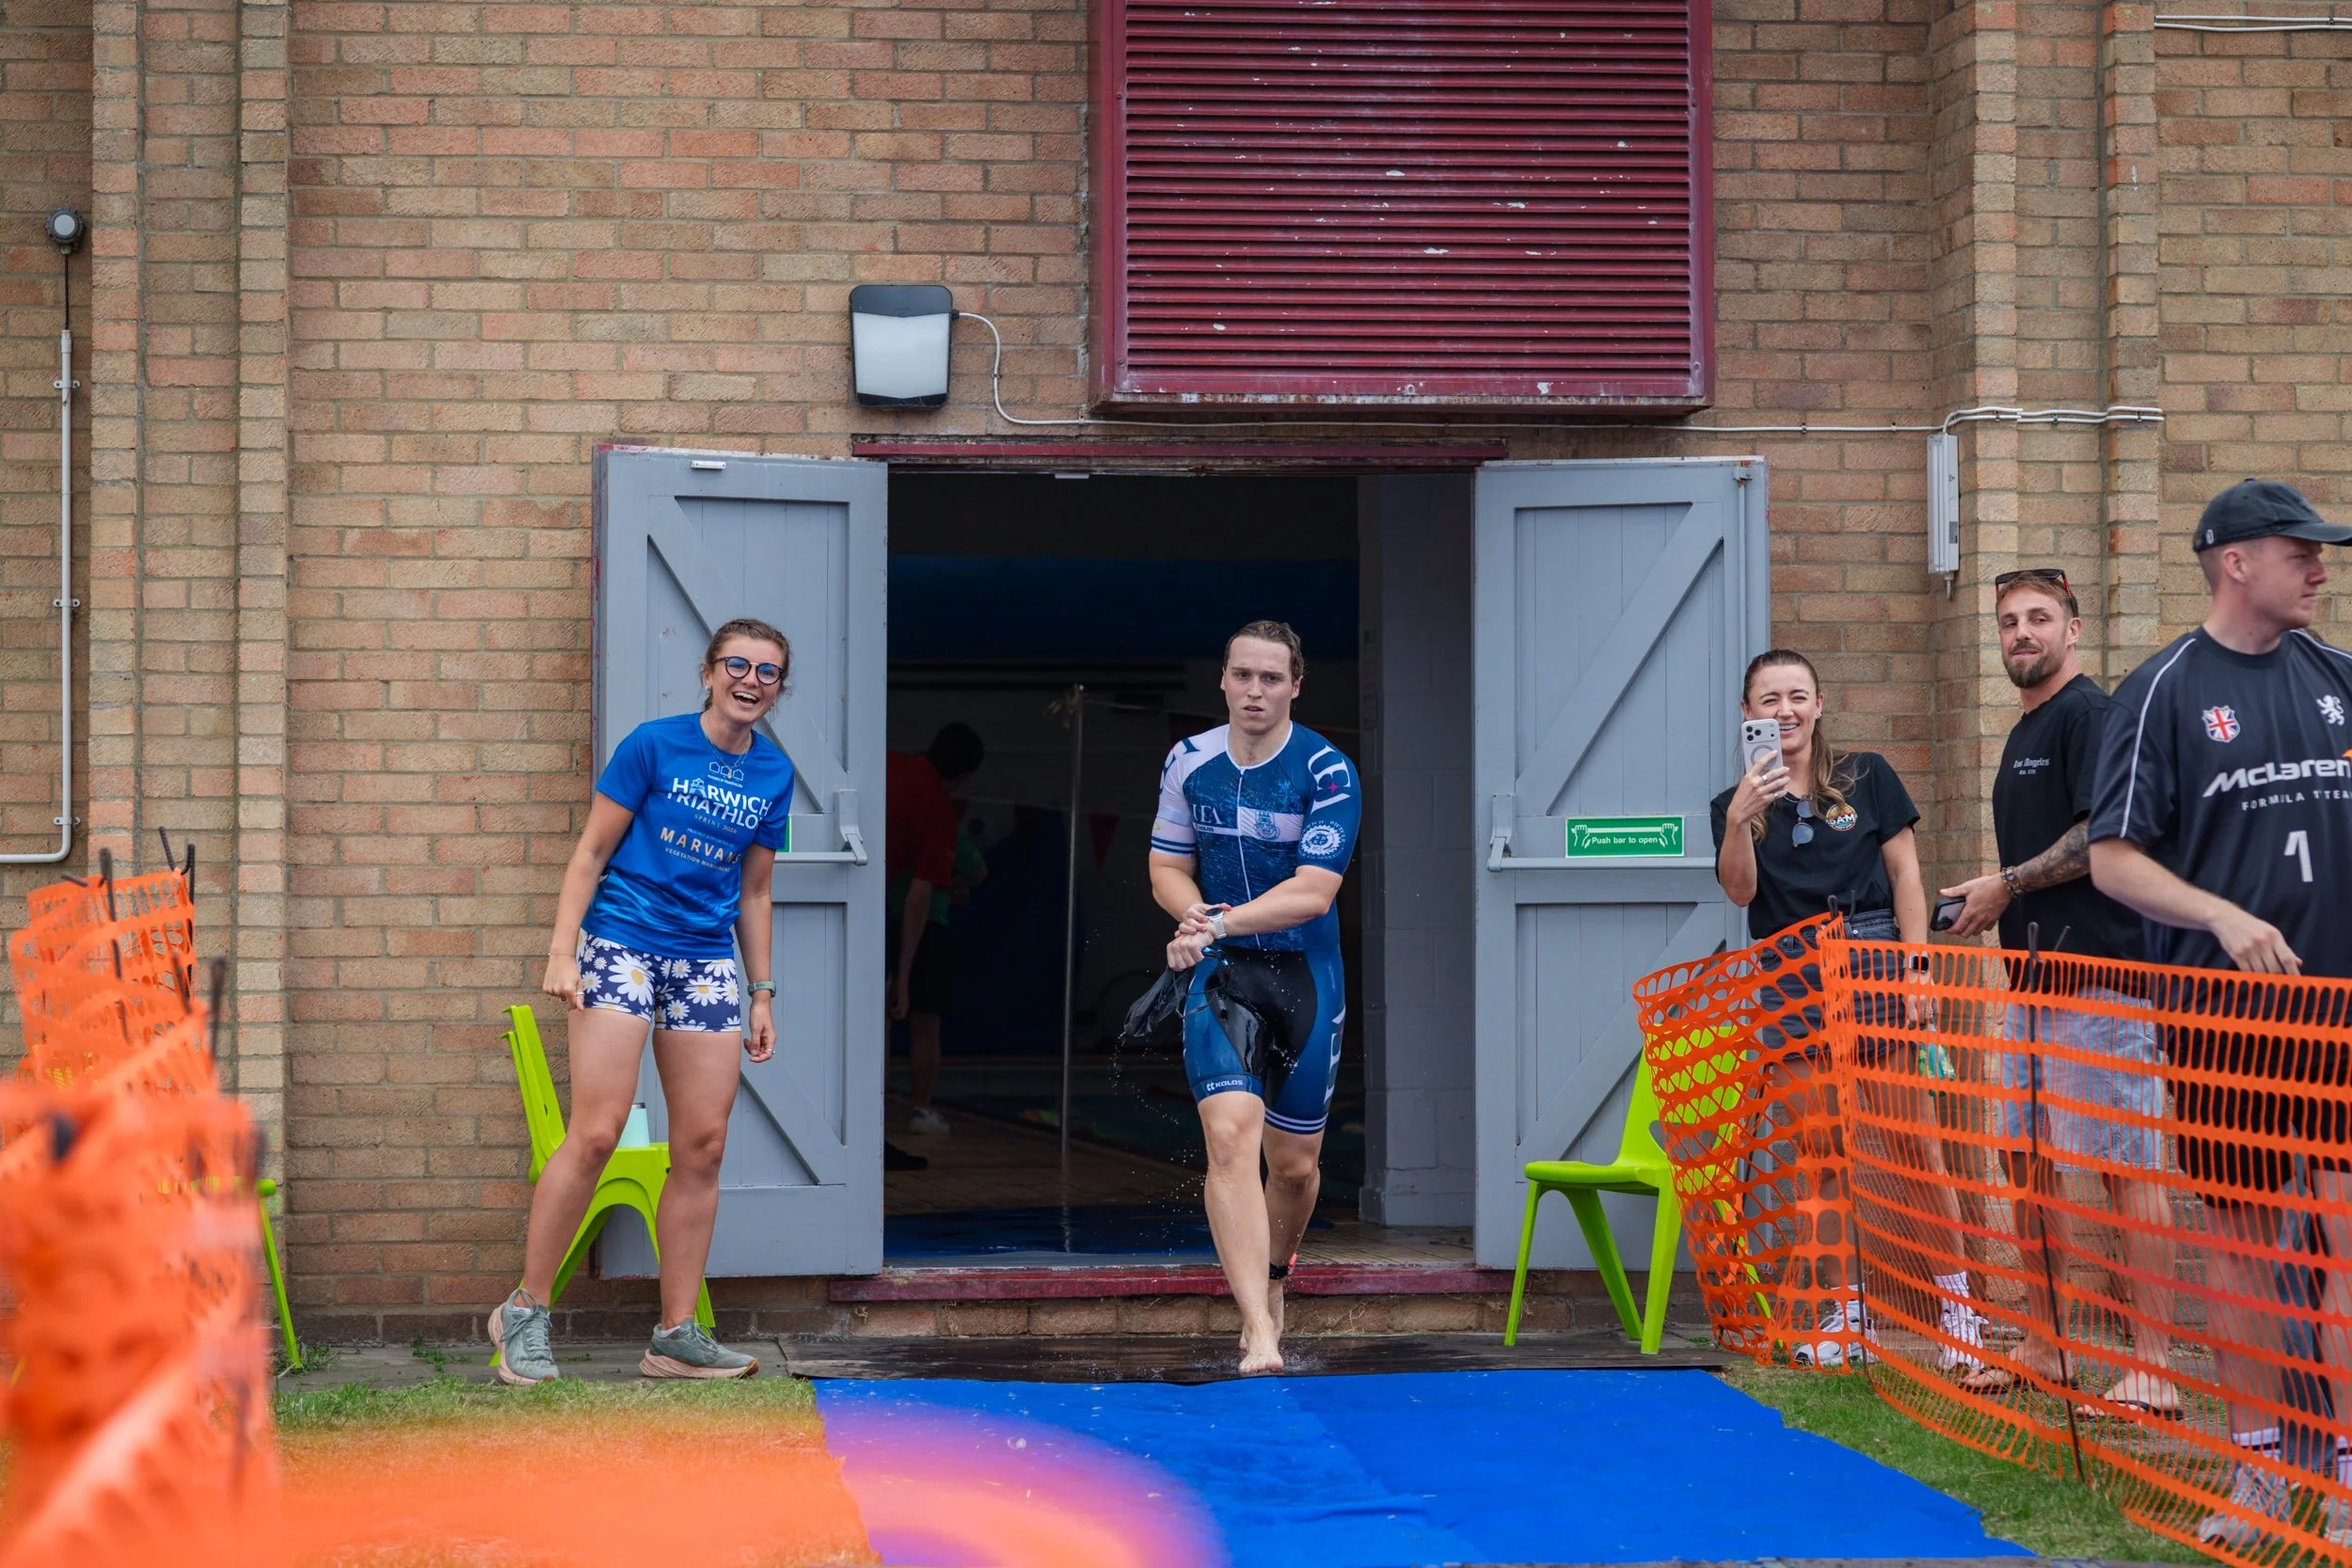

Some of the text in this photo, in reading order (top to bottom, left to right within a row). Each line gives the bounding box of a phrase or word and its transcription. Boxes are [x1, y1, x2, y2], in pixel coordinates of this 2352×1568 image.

[672, 777, 772, 816] HARWICH
[2201, 759, 2352, 798] McLaren
[2324, 790, 2352, 800] TEA
[667, 792, 763, 830] RIATHLO
[660, 827, 741, 864] MARVANS
[1638, 836, 1658, 846] open
[2284, 830, 2313, 882] 1
